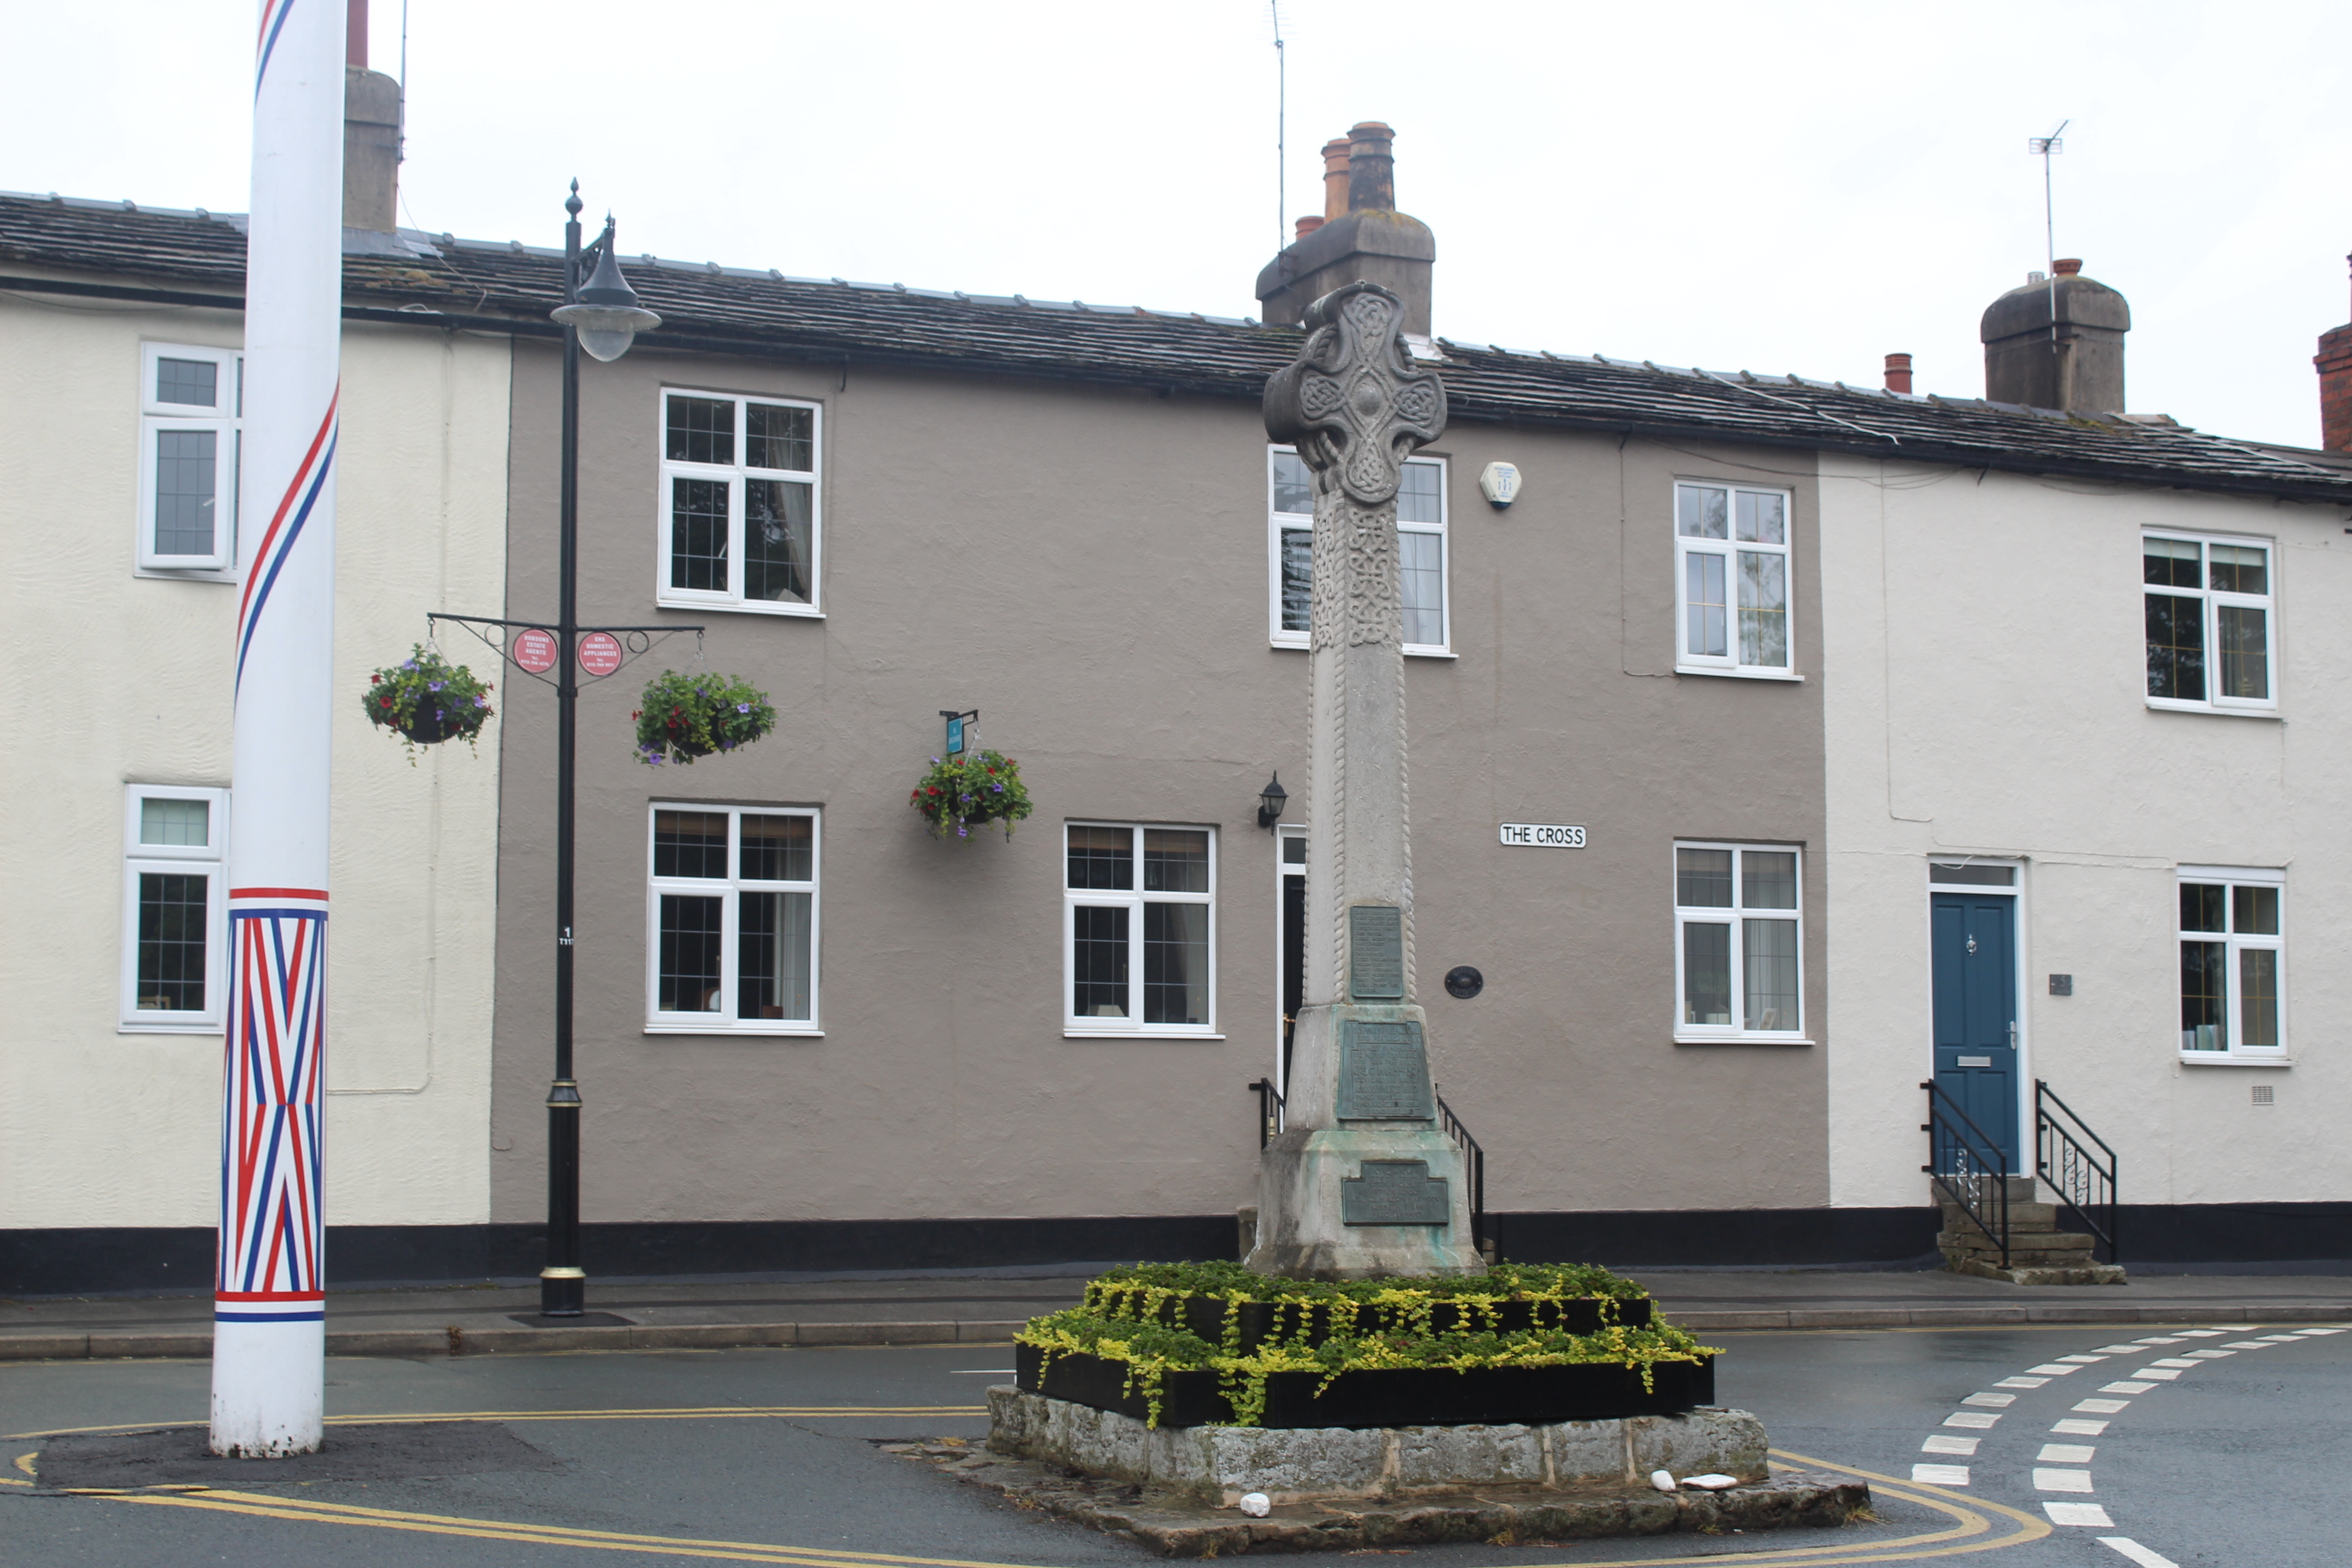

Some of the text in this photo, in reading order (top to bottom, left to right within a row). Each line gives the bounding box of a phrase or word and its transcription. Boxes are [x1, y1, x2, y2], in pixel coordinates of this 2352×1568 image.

[524, 634, 550, 643] DOBSONS
[526, 642, 546, 650] ESTATE
[525, 648, 547, 656] AGENTS
[1503, 827, 1583, 844] THE CROSS
[564, 926, 571, 938] 1
